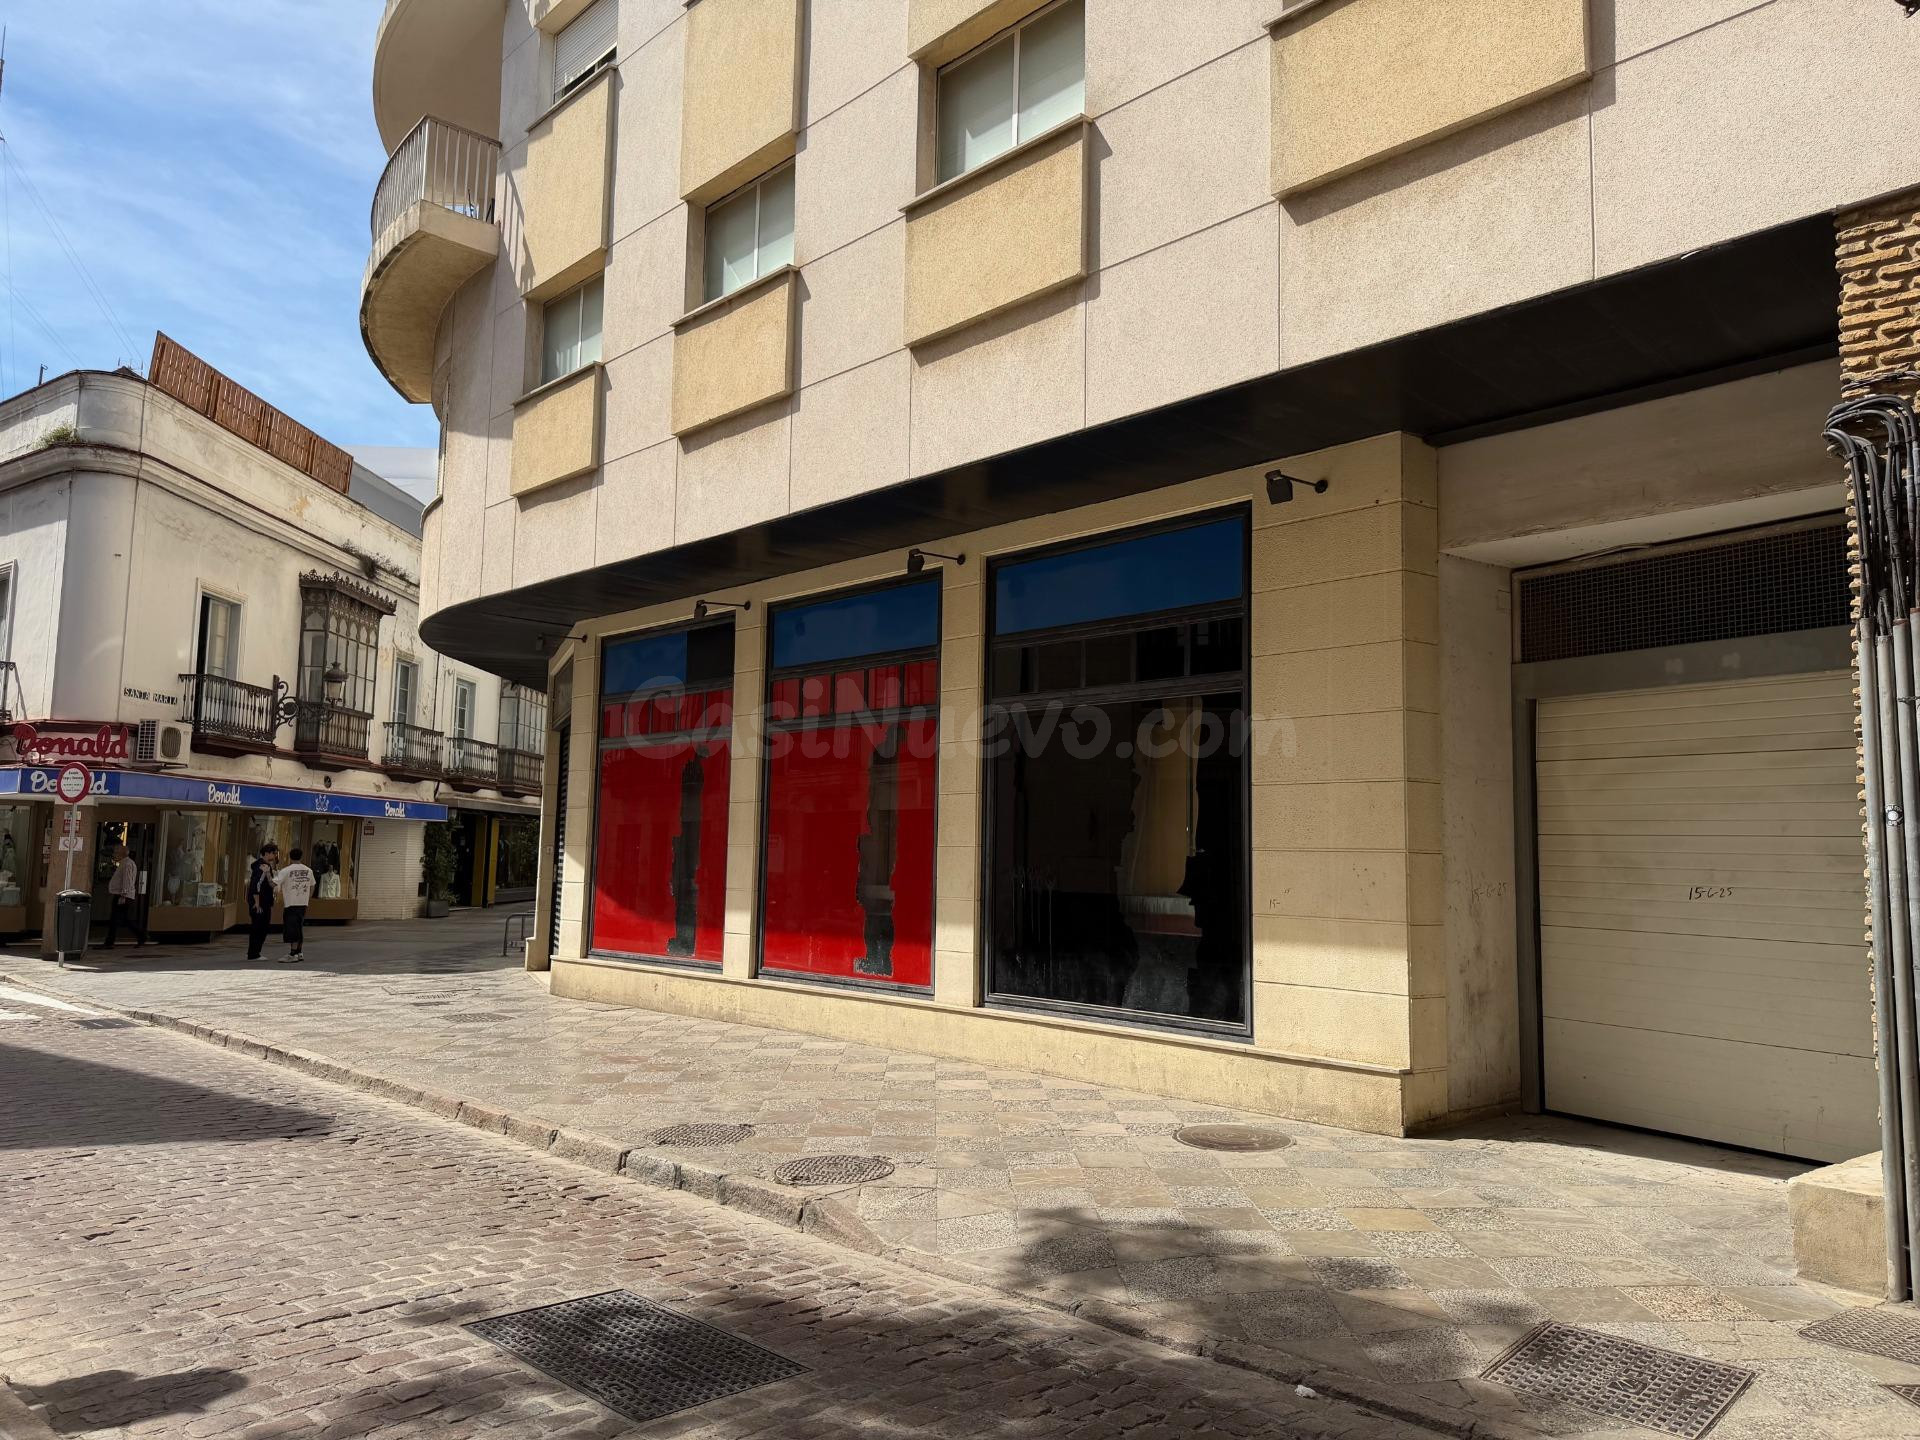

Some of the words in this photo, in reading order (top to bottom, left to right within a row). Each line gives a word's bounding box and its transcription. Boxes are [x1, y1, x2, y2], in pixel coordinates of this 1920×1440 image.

[123, 688, 150, 701] SANTA
[14, 723, 129, 759] Donald
[31, 770, 109, 795] Dold
[208, 783, 241, 805] Donald
[385, 801, 405, 817] Donald
[1689, 887, 1733, 900] 15-6-25
